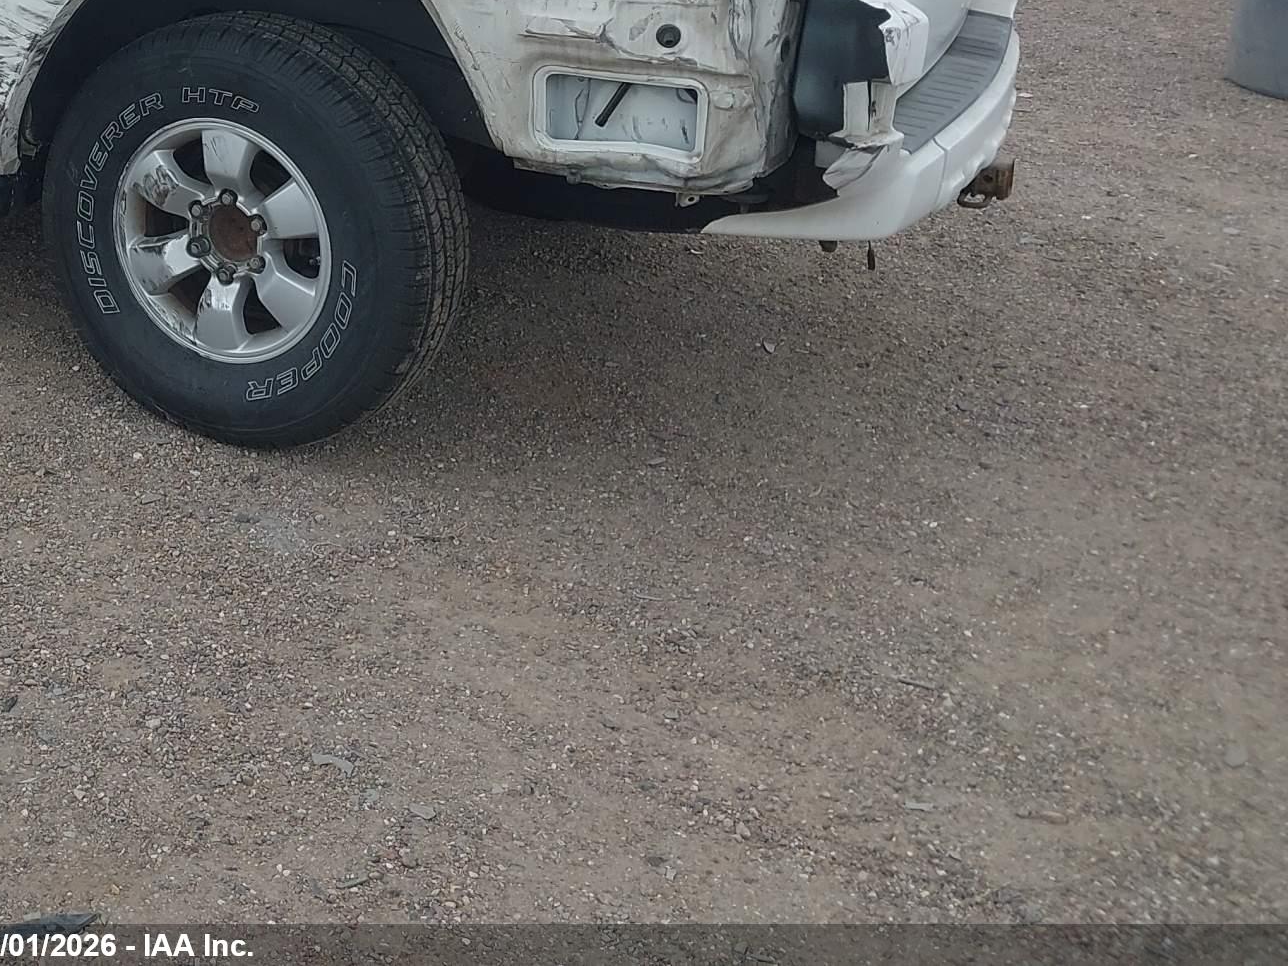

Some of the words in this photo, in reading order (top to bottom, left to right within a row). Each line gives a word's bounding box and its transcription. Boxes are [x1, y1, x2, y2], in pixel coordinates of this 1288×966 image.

[73, 91, 164, 315] DISCOVERER
[182, 87, 259, 114] HTP
[246, 261, 356, 403] COOPER
